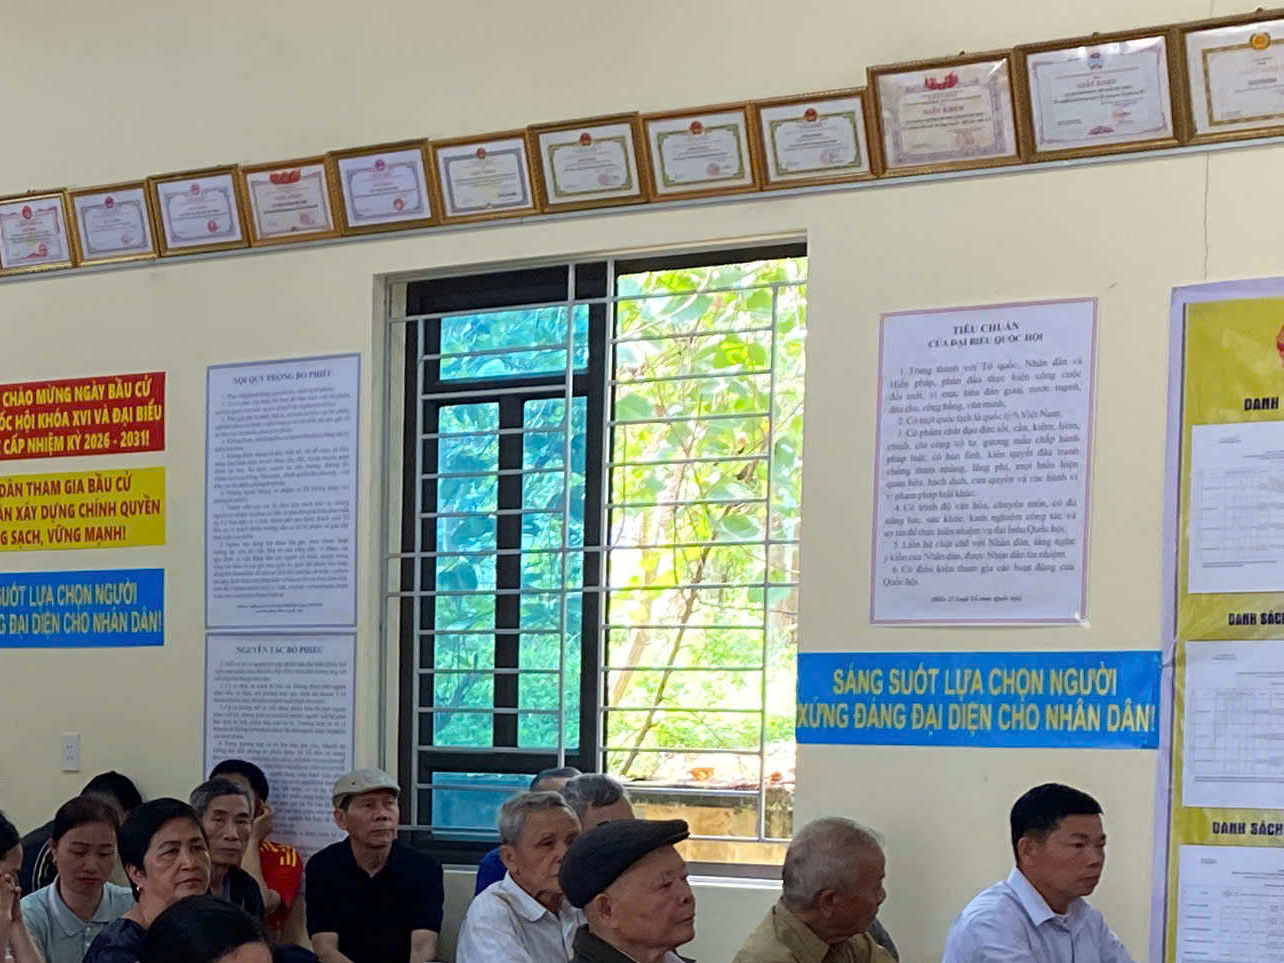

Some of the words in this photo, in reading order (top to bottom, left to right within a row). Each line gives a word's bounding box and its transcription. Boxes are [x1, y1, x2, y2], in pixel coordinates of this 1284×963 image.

[2, 385, 34, 408] CHÀO
[35, 383, 73, 405] MỪNG
[74, 379, 106, 403] NGÀY
[107, 376, 133, 400] BẦU
[135, 374, 153, 398] CỬ
[1244, 396, 1279, 411] DANH
[14, 408, 36, 434] HỘI
[37, 407, 71, 430] KHÓA
[72, 409, 92, 427] XVI
[93, 403, 111, 426] VÀ
[112, 406, 134, 428] ĐẠI
[136, 398, 163, 423] BIỂU
[3, 432, 26, 455] CẤP
[27, 431, 65, 457] NHIỆM
[66, 429, 82, 452] KỲ
[83, 432, 111, 451] 2026
[25, 479, 62, 497] THAM
[64, 478, 85, 495] GIA
[87, 471, 113, 494] BẦU
[115, 470, 133, 492] CỬ
[15, 500, 39, 522] XÂY
[40, 501, 77, 524] DỰNG
[78, 497, 117, 519] CHÍNH
[119, 494, 161, 518] QUYỀN
[10, 528, 44, 549] SẠCH,
[47, 523, 82, 544] VỮNG
[84, 525, 127, 547] MẠNH!
[1228, 612, 1257, 626] DANH
[833, 661, 884, 696] SÁNG
[889, 661, 939, 696] SUỐT
[944, 667, 984, 703] LỰA
[988, 667, 1045, 702] CHỌN
[1050, 660, 1118, 697] NGƯỜI
[854, 695, 906, 730] ĐÁNG
[911, 702, 943, 737] ĐẠI
[948, 701, 993, 738] DIỆN
[997, 703, 1041, 731] CHO
[1045, 697, 1101, 733] NHÂN
[1212, 821, 1246, 834] DANH
[1250, 819, 1283, 836] SÁCH
